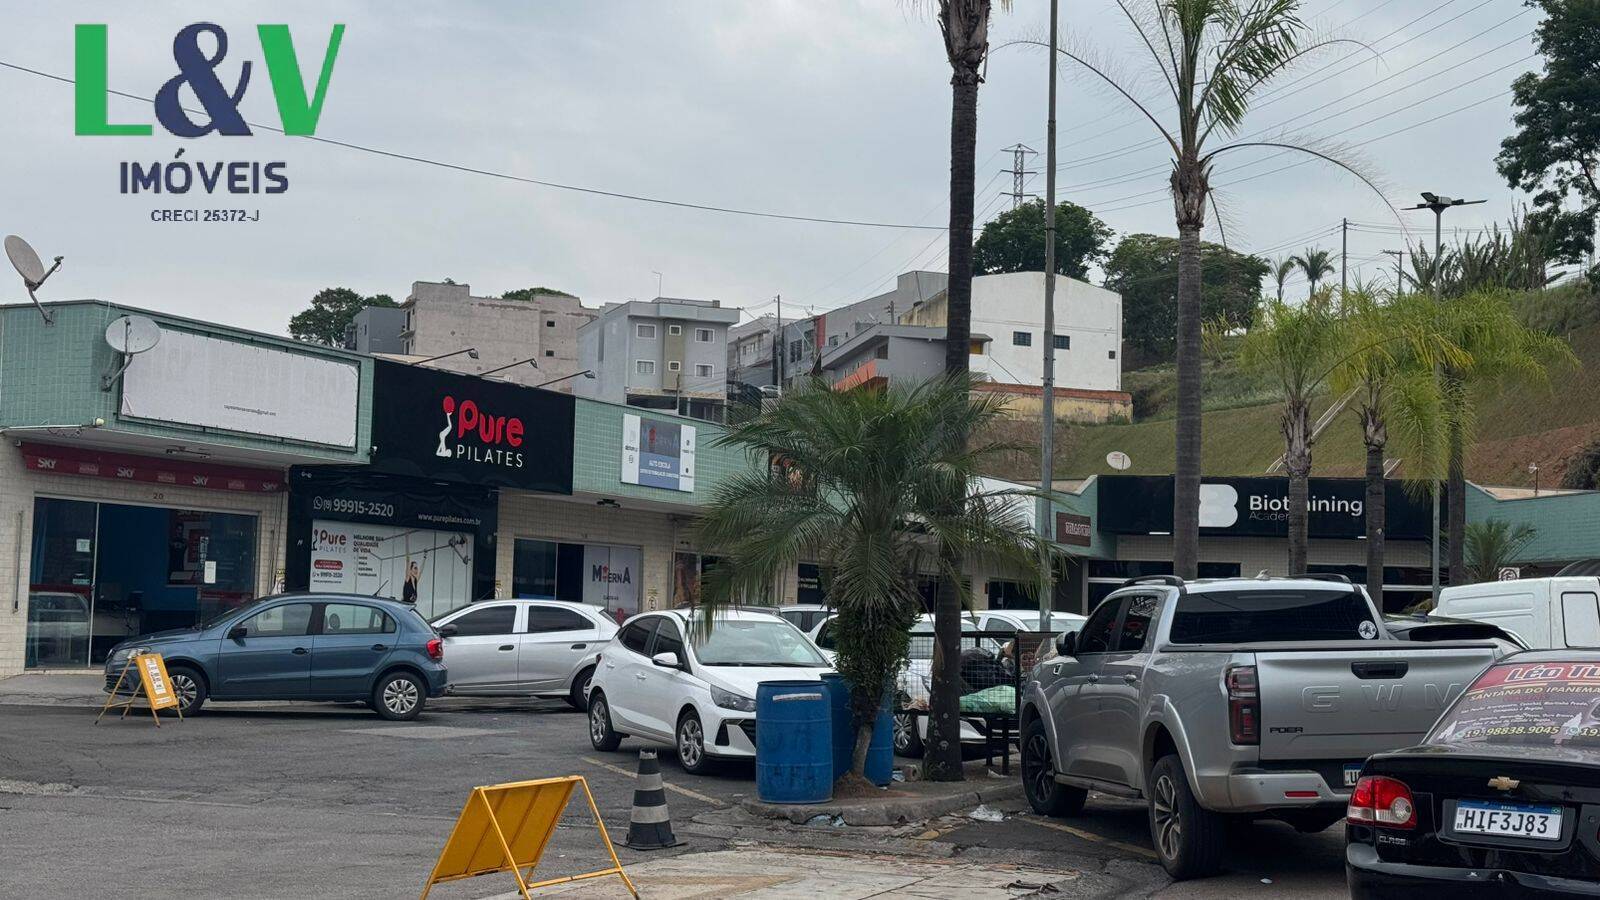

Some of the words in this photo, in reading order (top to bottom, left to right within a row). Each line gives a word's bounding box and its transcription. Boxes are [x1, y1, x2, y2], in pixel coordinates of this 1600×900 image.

[458, 400, 524, 447] Pure
[37, 458, 56, 469] SKY
[457, 444, 523, 468] PILATES
[117, 467, 136, 478] SKY
[192, 475, 209, 486] SKY
[262, 481, 278, 491] SKY
[333, 498, 394, 517] 99915-2520
[1249, 495, 1362, 516] Biotining
[320, 529, 347, 546] Pure
[319, 546, 347, 554] PILATES
[1505, 665, 1564, 682] Léo
[1470, 689, 1522, 701] SANTANA
[1524, 686, 1544, 694] DO
[1546, 686, 1600, 694] IPANEMA
[1486, 726, 1560, 736] 98838.9045
[1463, 809, 1549, 834] HIF3J83
